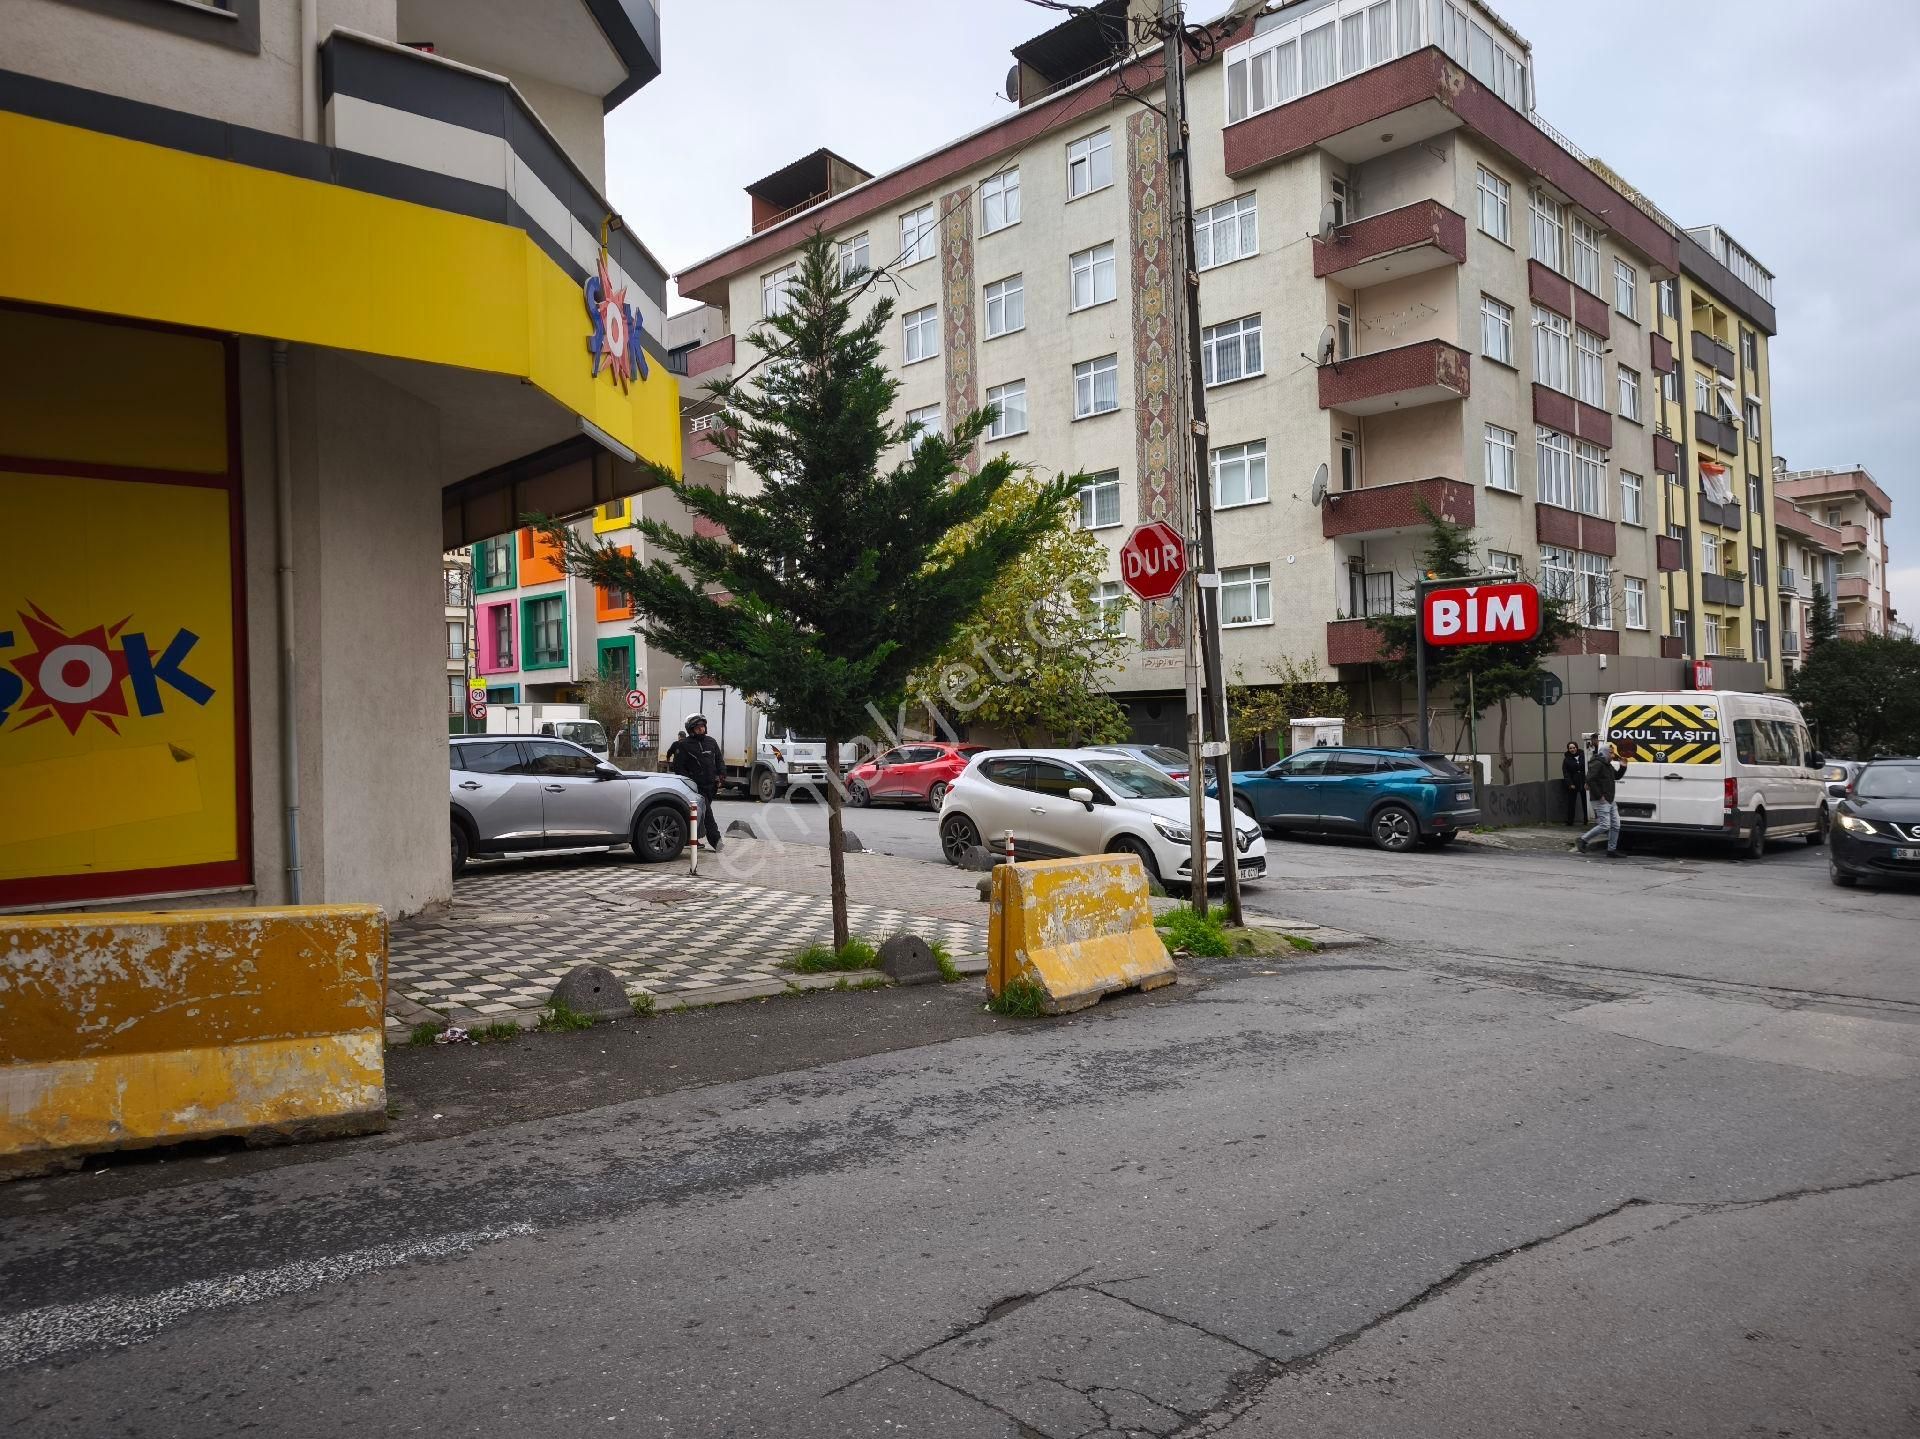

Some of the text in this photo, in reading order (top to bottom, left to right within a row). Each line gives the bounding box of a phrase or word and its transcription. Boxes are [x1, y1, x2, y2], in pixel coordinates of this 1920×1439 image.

[1127, 544, 1180, 578] DUR
[1432, 587, 1526, 636] BİM
[1611, 729, 1656, 740] OKUL
[1662, 730, 1716, 742] TAŞITI
